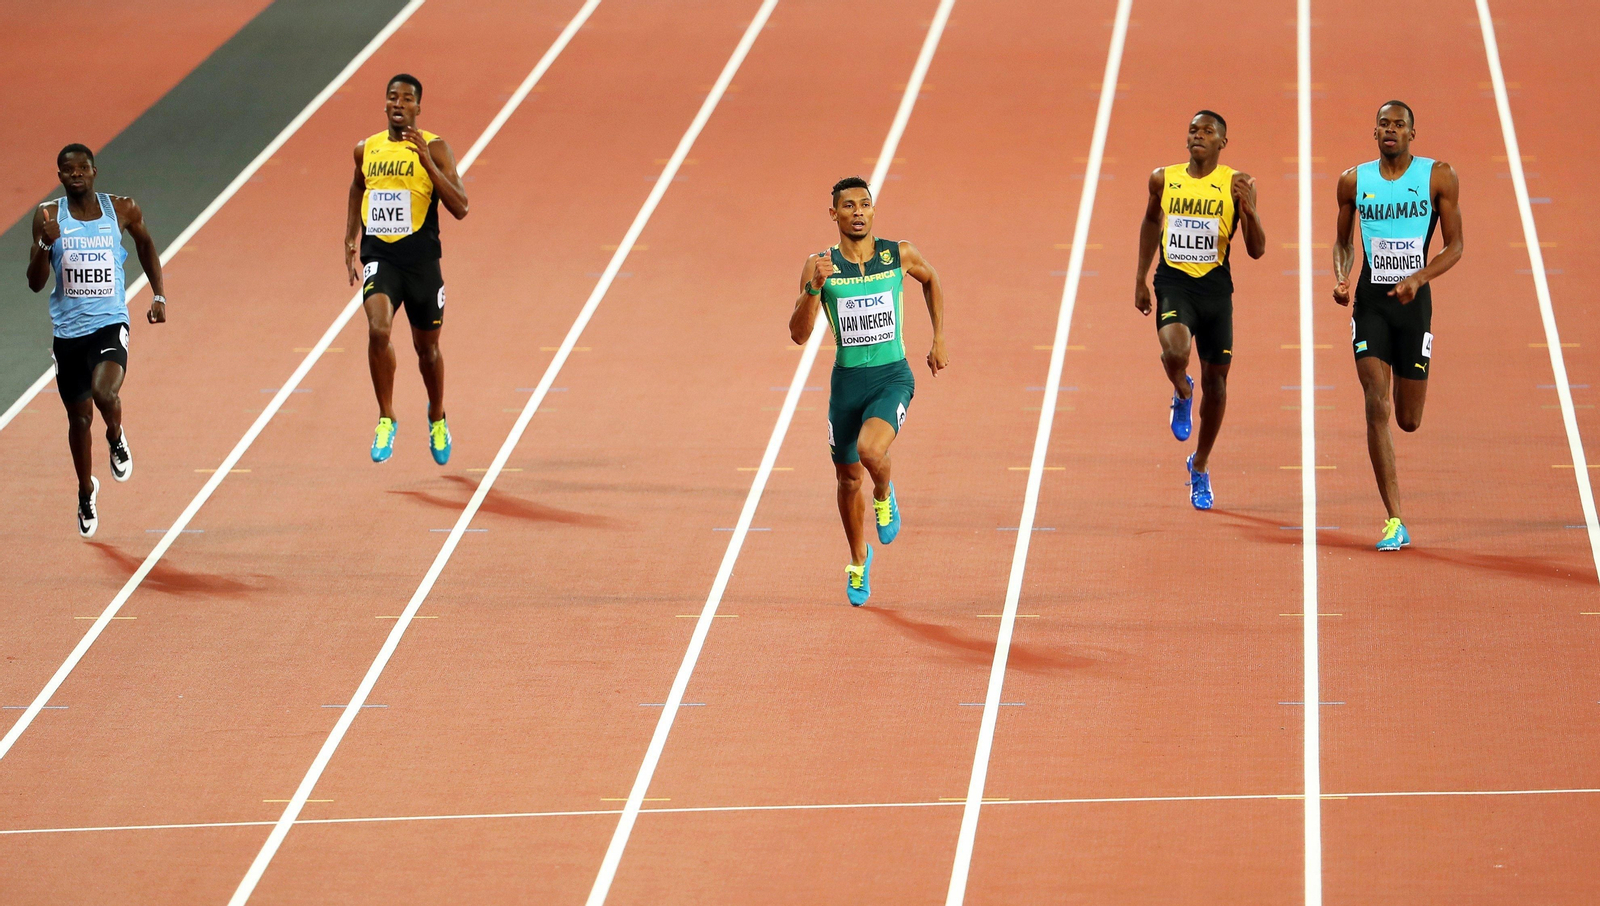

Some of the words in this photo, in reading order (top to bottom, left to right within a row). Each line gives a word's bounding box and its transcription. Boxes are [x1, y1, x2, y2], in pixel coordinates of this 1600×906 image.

[367, 161, 414, 177] JAMAICA
[379, 192, 402, 201] TDK
[1169, 197, 1224, 216] JAMAICA
[1359, 200, 1428, 220] BAHAMAS
[372, 207, 404, 221] GAYE
[1183, 219, 1210, 230] TDK
[62, 235, 114, 249] BOTSWANA
[1169, 233, 1214, 250] ALLEN
[1387, 241, 1415, 250] TDK
[79, 252, 107, 262] TDK
[1167, 253, 1198, 261] LONDON
[1373, 254, 1422, 270] GARDINER
[65, 268, 112, 283] THEBE
[830, 277, 864, 286] SOUTH
[866, 270, 896, 283] AFRICA
[65, 288, 97, 296] LONDON
[97, 288, 113, 296] 2017
[854, 295, 885, 308] TDK
[840, 316, 859, 332] VAN
[859, 311, 894, 331] NIEKERK
[843, 335, 877, 345] LONDON
[877, 331, 894, 341] 2017
